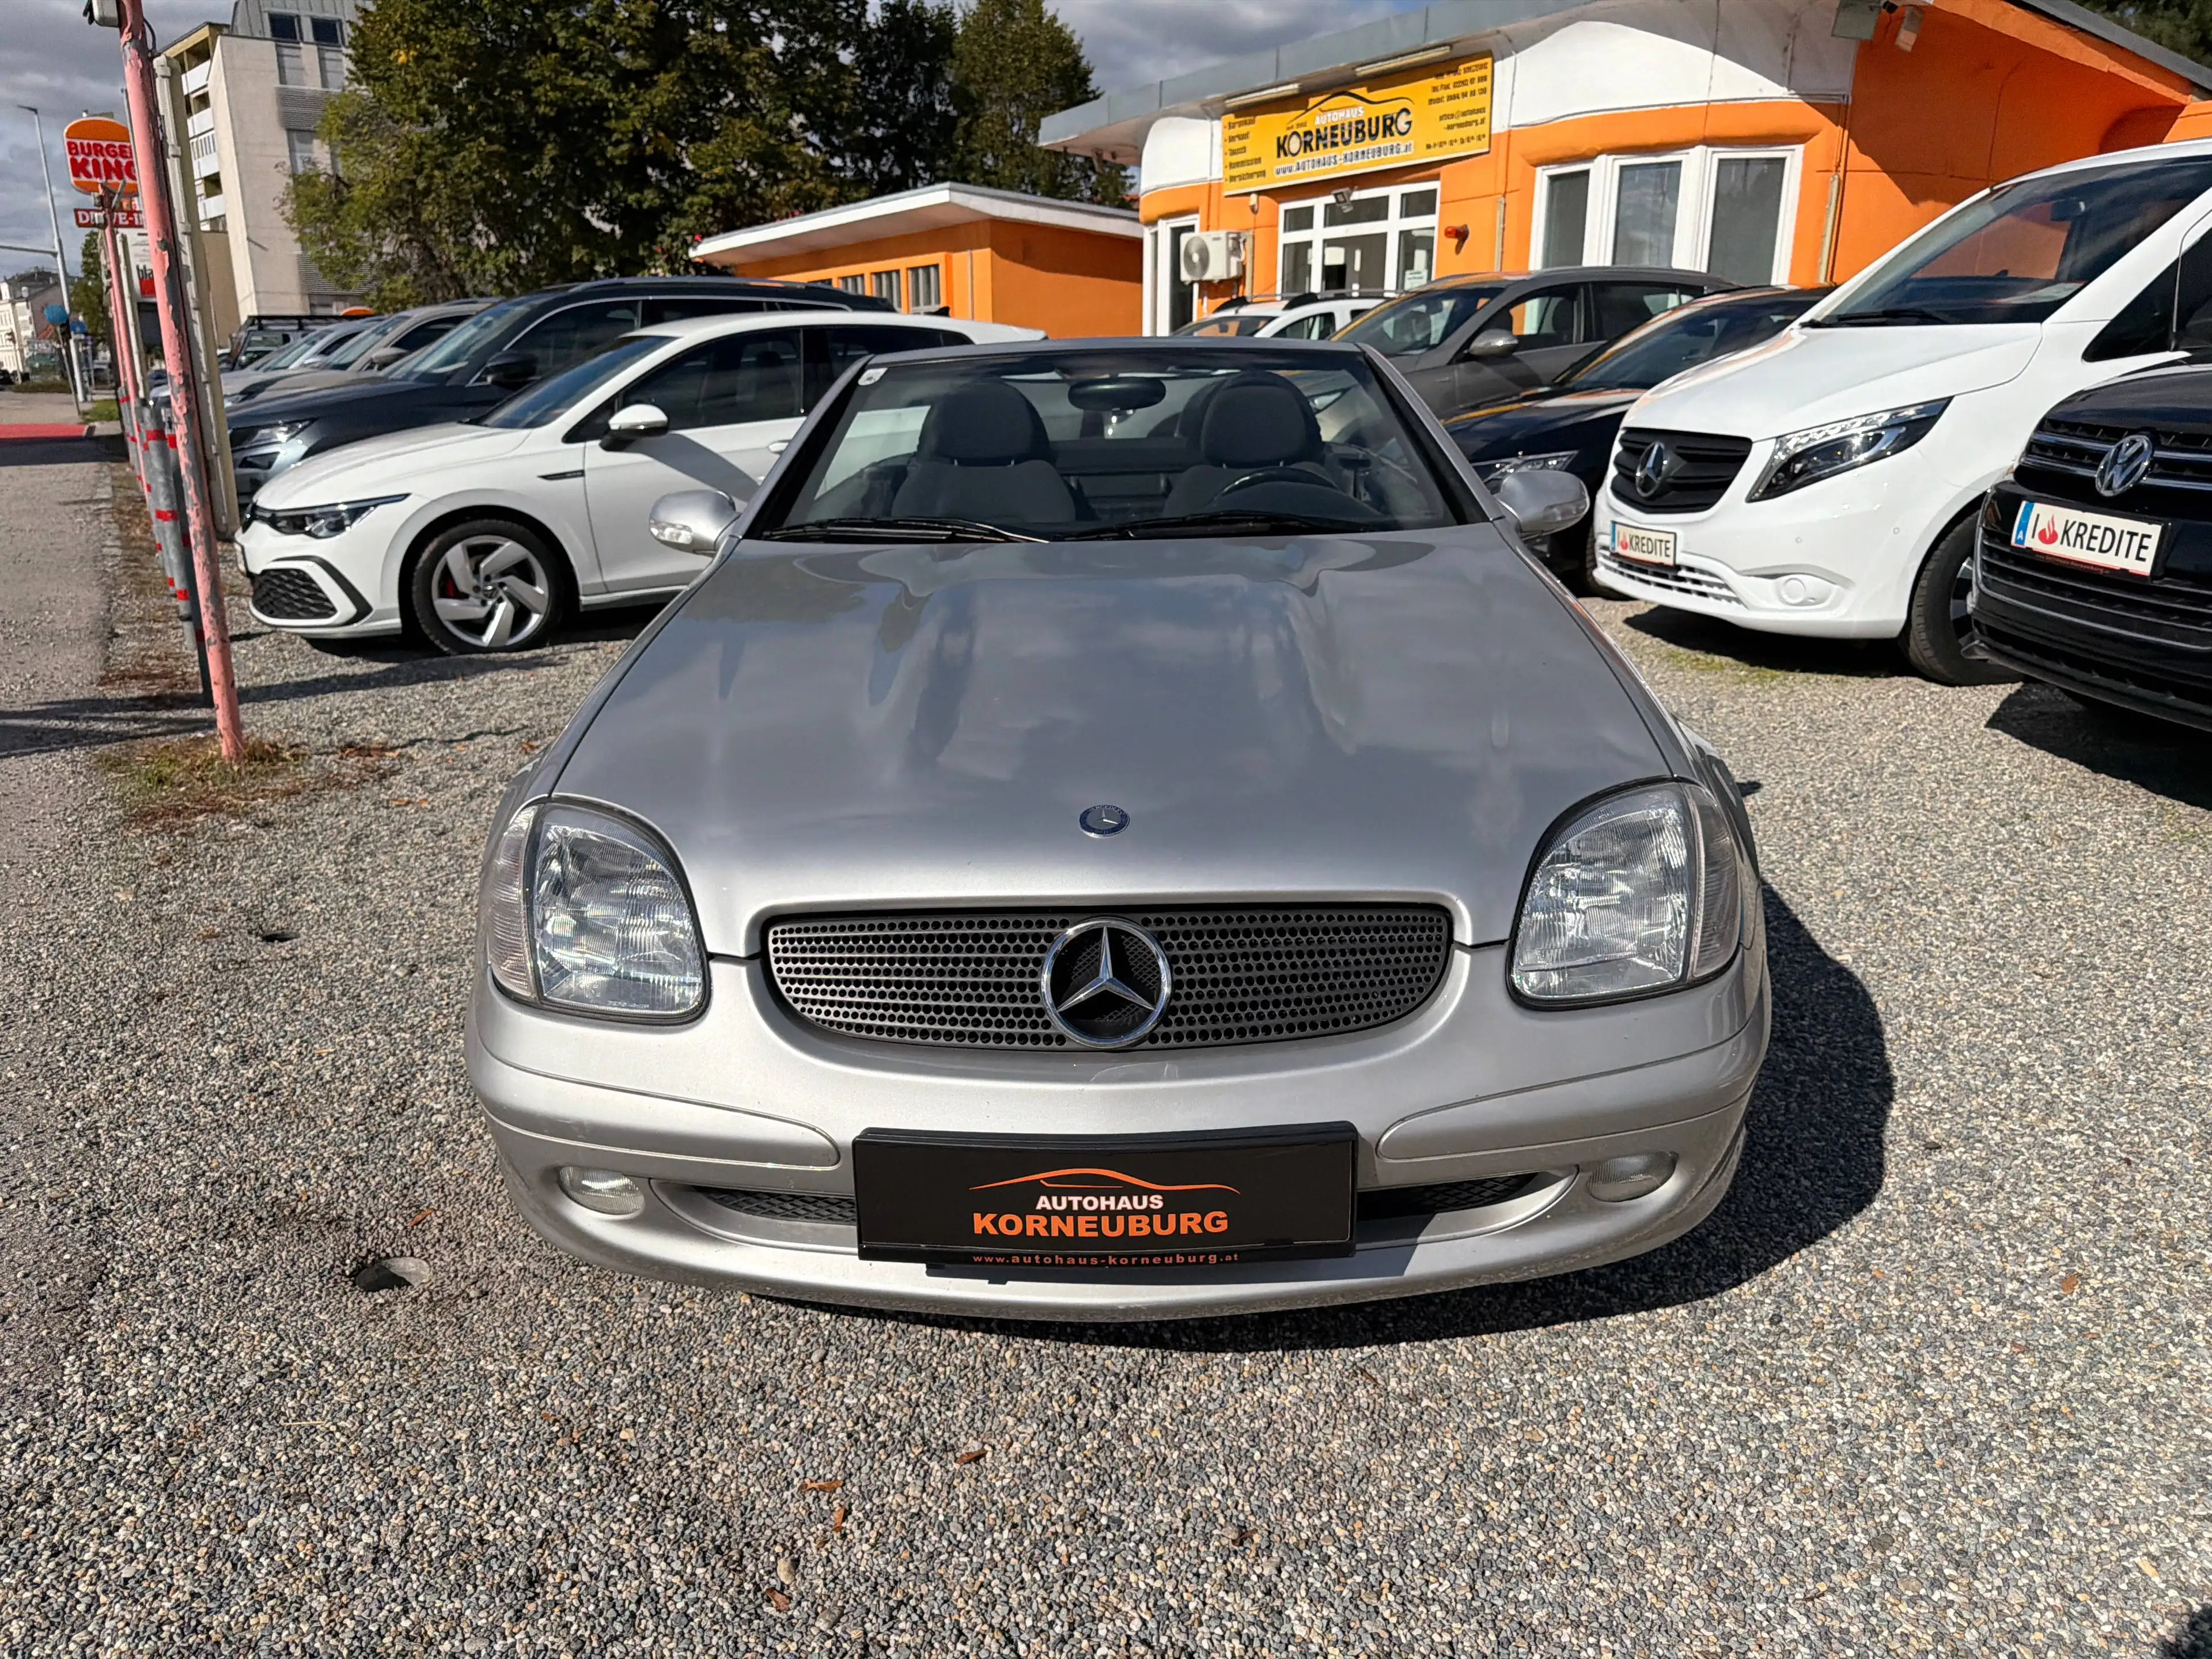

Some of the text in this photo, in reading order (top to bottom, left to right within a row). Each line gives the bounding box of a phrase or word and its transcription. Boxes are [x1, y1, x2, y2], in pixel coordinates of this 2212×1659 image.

[1315, 106, 1364, 125] AUTOHAUS
[1277, 108, 1412, 158] KORNEUBURG
[67, 141, 132, 158] BURGE
[1629, 533, 1671, 558] KREDITE
[2060, 520, 2152, 562] KREDITE
[1036, 1195, 1164, 1210] AUTOHAUS
[973, 1211, 1228, 1237] KORNEUBURG
[973, 1253, 1238, 1265] www.autohaus-korneuburg.at
